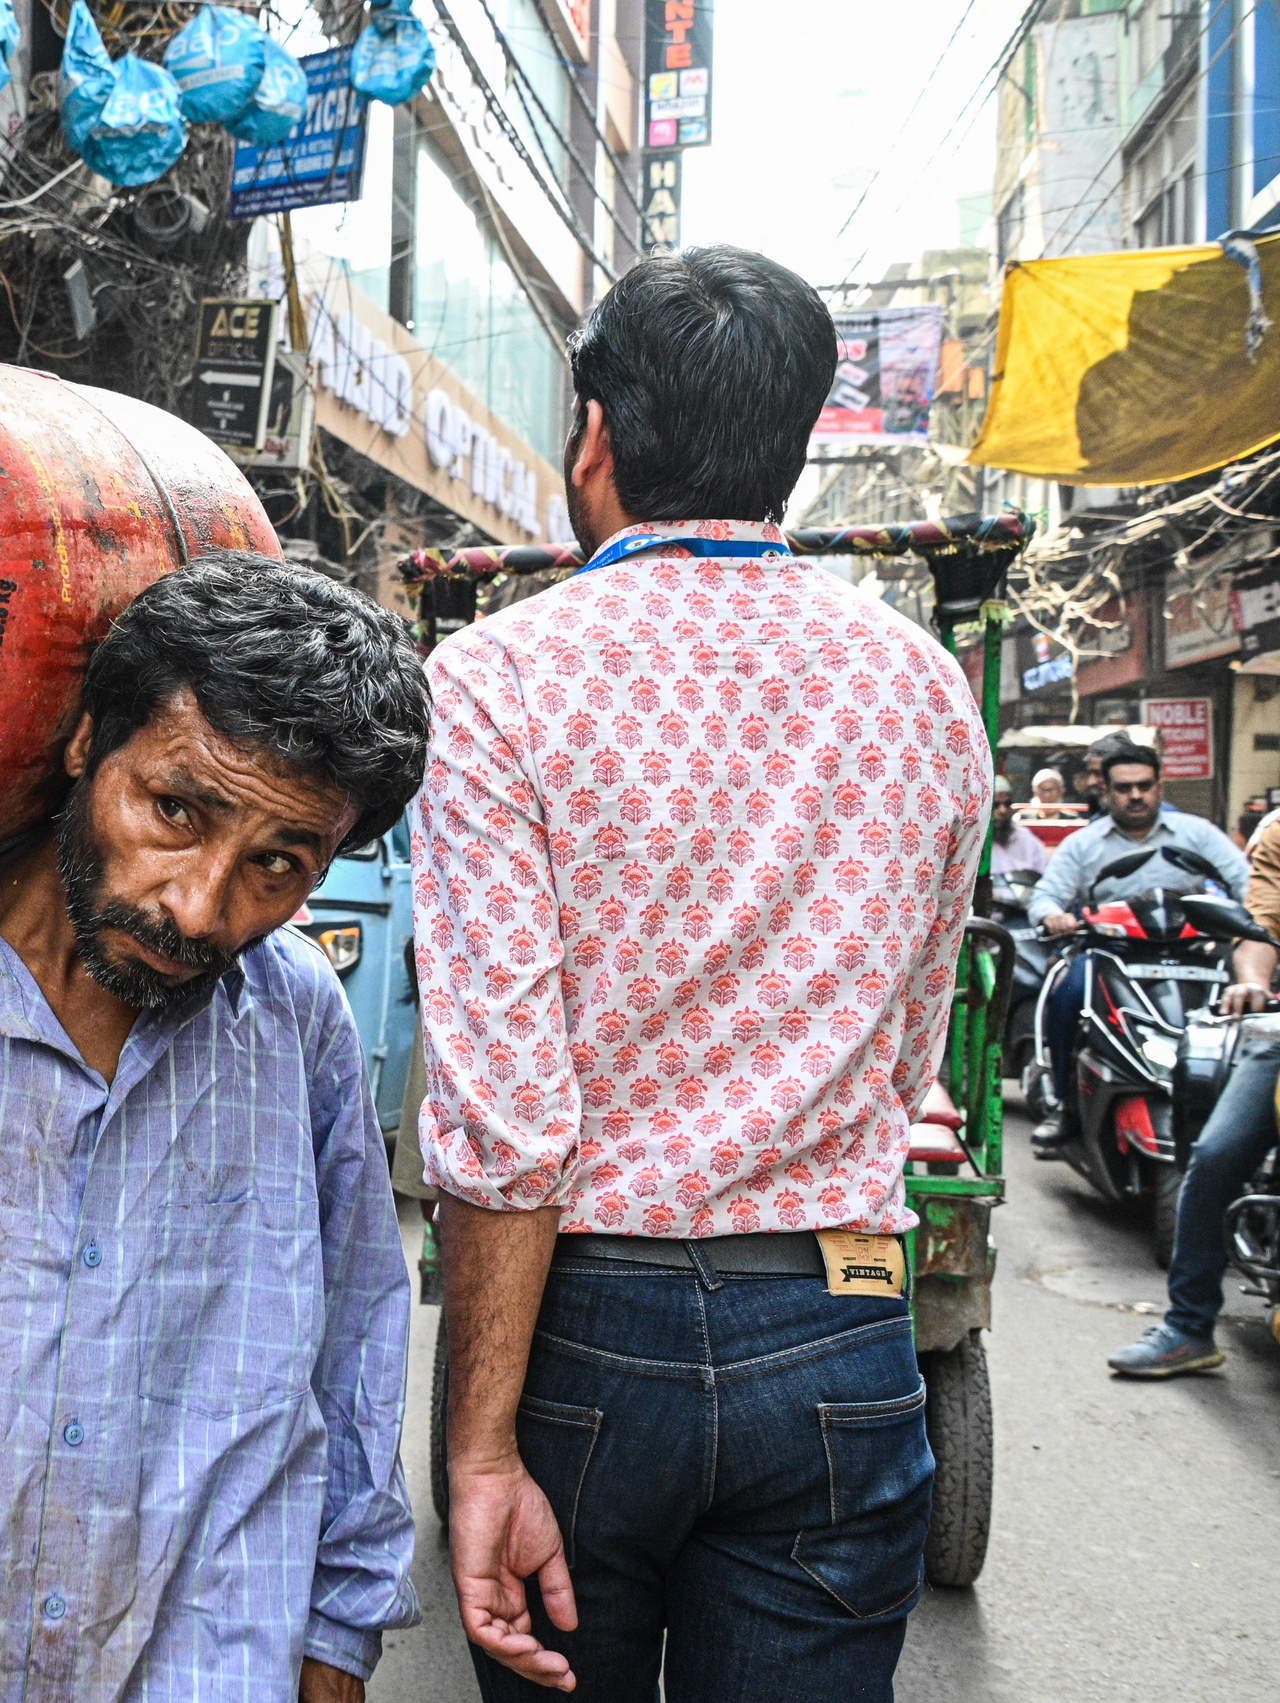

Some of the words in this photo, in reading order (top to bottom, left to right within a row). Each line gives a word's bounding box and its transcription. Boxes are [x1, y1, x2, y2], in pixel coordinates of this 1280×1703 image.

[664, 0, 694, 69] NTE
[209, 307, 262, 339] ACE
[1149, 704, 1206, 726] NOBLE
[848, 1268, 886, 1277] VINTAGE
